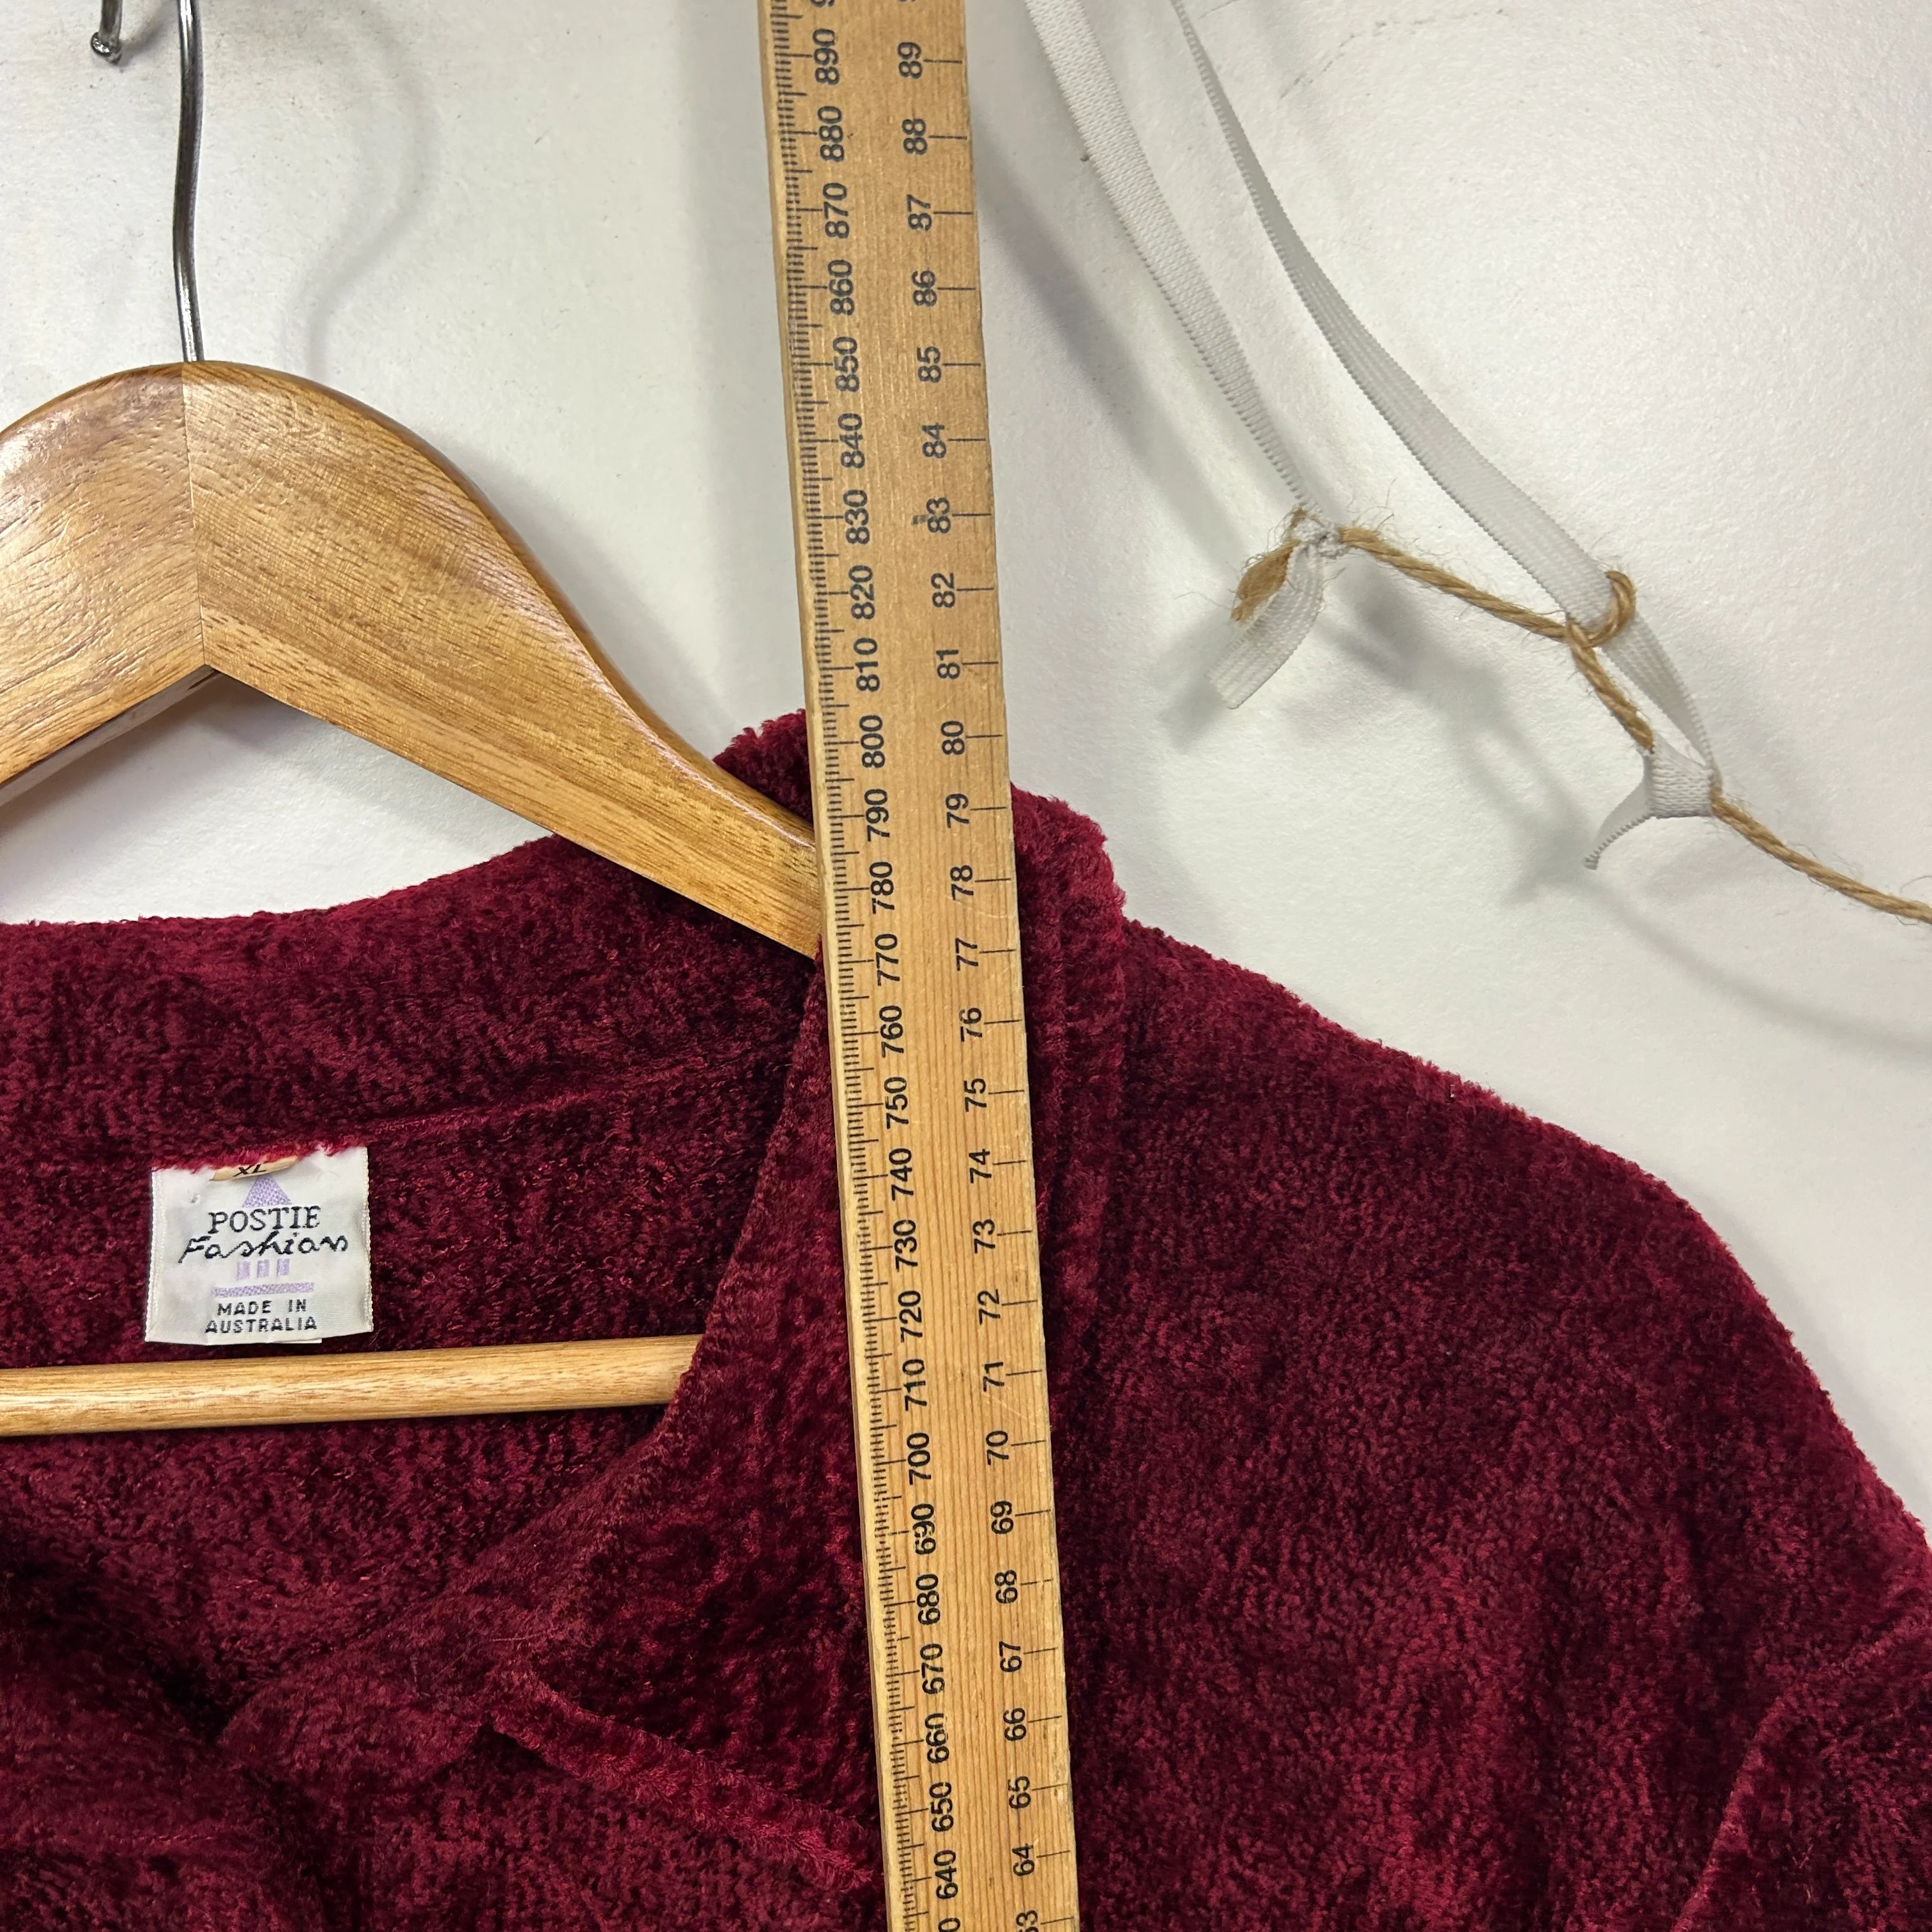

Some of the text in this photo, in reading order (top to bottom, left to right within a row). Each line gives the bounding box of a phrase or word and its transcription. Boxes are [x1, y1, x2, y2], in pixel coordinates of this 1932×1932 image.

[813, 29, 839, 84] 890
[898, 42, 922, 79] 89
[818, 106, 844, 162] 880
[902, 118, 927, 155] 88
[823, 183, 849, 238] 870
[907, 194, 931, 231] 87
[828, 259, 854, 316] 860
[912, 271, 937, 306] 86
[833, 337, 859, 392] 850
[917, 346, 941, 382] 85
[838, 413, 864, 468] 840
[922, 424, 946, 458] 84
[843, 490, 870, 544] 830
[926, 498, 951, 533] 83
[848, 565, 875, 619] 820
[931, 573, 955, 608] 82
[854, 638, 880, 692] 810
[936, 650, 960, 679] 81
[859, 715, 885, 769] 800
[941, 721, 965, 755] 80
[864, 789, 890, 842] 790
[946, 793, 969, 829] 79
[870, 862, 894, 914] 780
[950, 865, 974, 900] 78
[875, 934, 900, 986] 770
[955, 938, 978, 971] 77
[879, 1006, 904, 1058] 760
[959, 1008, 983, 1043] 76
[884, 1077, 908, 1130] 750
[963, 1078, 986, 1112] 75
[233, 1164, 267, 1177] XL
[889, 1148, 914, 1201] 740
[969, 1149, 992, 1184] 74
[208, 1205, 321, 1234] POSTIE
[972, 1219, 995, 1254] 73
[178, 1230, 349, 1263] Fashion
[893, 1220, 918, 1272] 730
[205, 1317, 318, 1333] AUSTRALIA
[217, 1299, 307, 1315] MADE IN
[898, 1290, 923, 1342] 720
[977, 1289, 1000, 1325] 72
[902, 1359, 927, 1411] 710
[983, 1362, 1004, 1392] 71
[907, 1432, 931, 1485] 700
[986, 1430, 1009, 1466] 70
[910, 1503, 936, 1555] 690
[990, 1501, 1013, 1536] 69
[916, 1574, 940, 1625] 680
[995, 1570, 1018, 1604] 68
[920, 1643, 945, 1694] 670
[999, 1641, 1022, 1674] 67
[924, 1713, 949, 1763] 660
[1003, 1707, 1027, 1742] 66
[929, 1781, 954, 1832] 650
[1008, 1776, 1031, 1809] 65
[933, 1850, 958, 1900] 640
[1012, 1843, 1035, 1877] 64
